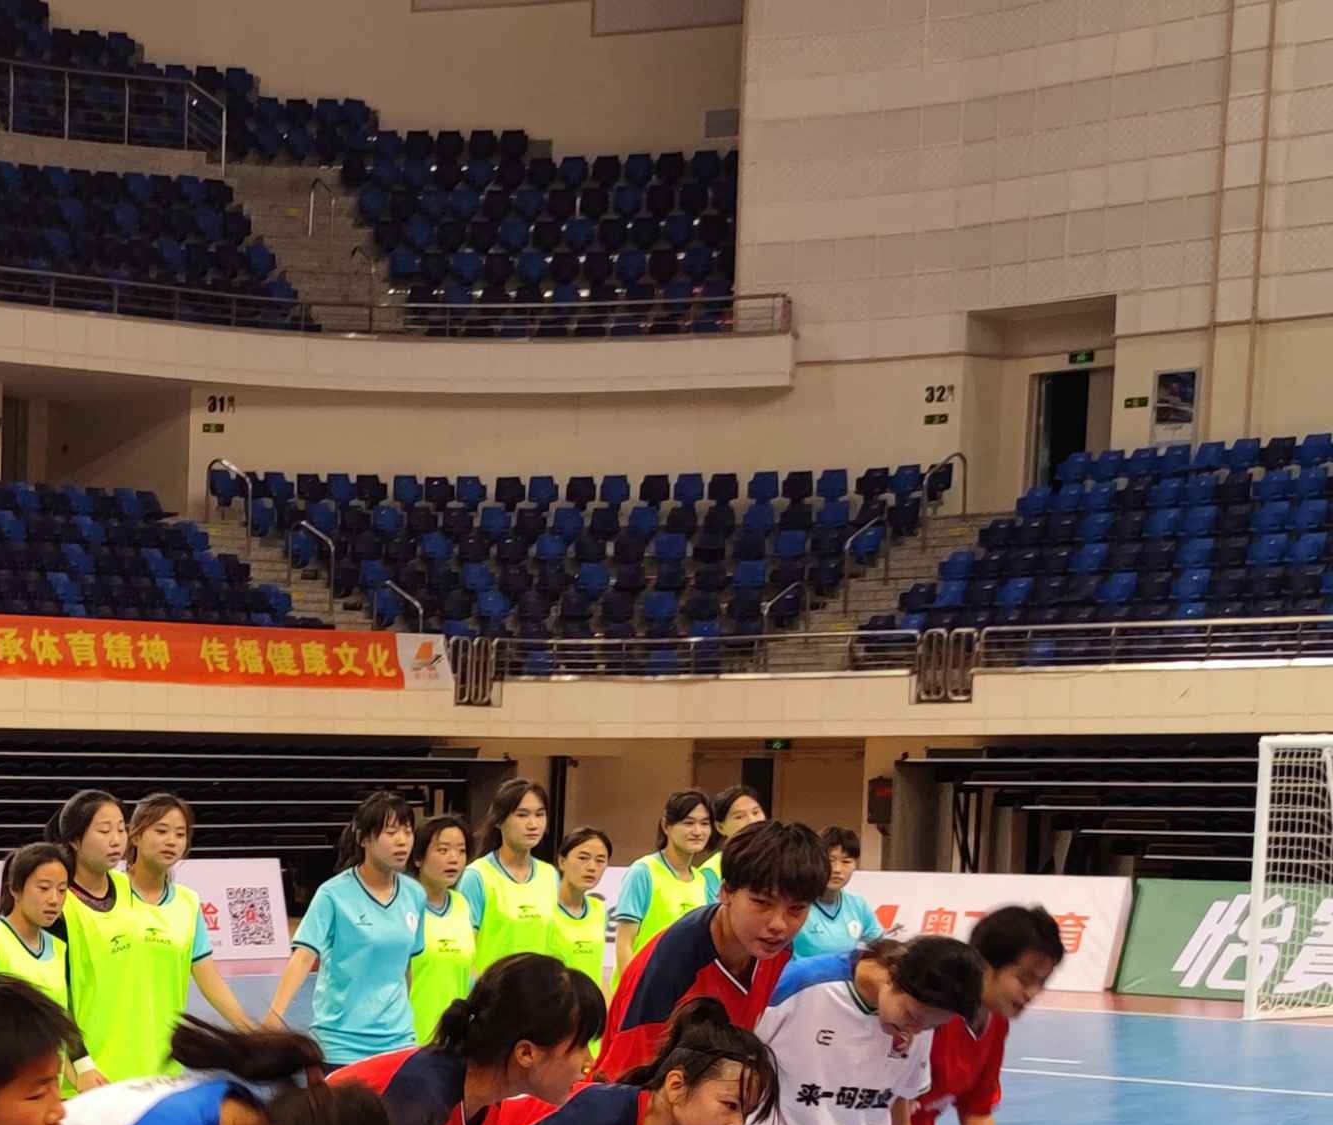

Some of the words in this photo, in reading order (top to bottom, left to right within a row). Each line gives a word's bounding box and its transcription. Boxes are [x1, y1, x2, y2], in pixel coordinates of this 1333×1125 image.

[925, 385, 946, 403] 32
[199, 636, 396, 679] 传播健康文化
